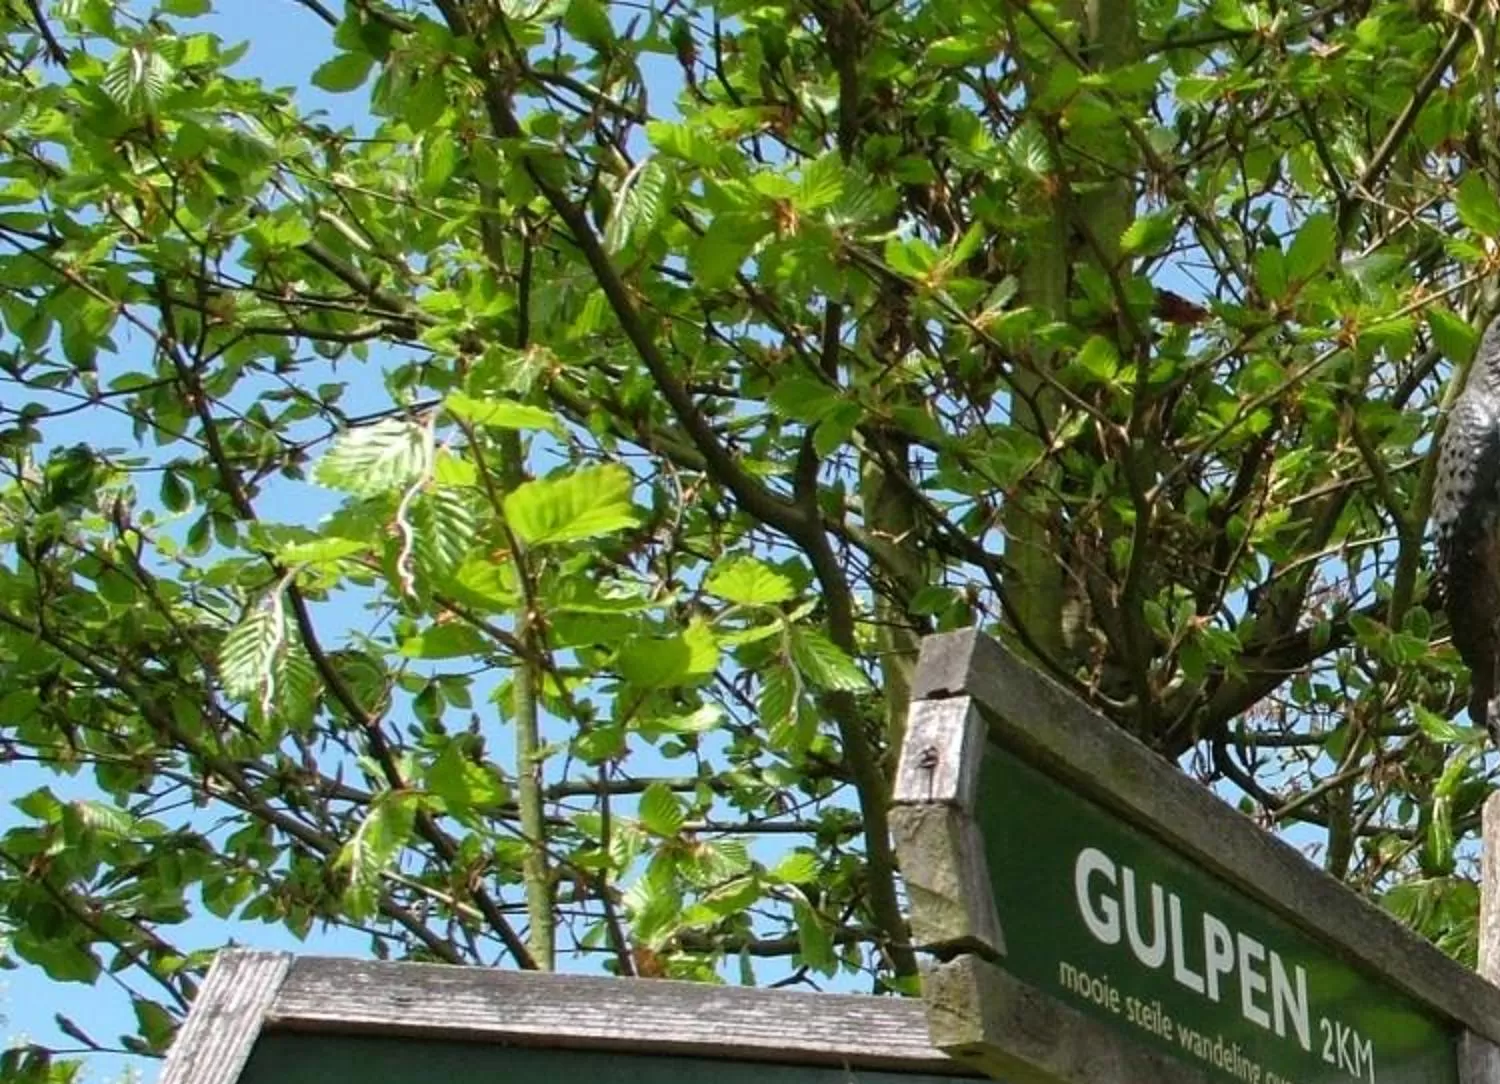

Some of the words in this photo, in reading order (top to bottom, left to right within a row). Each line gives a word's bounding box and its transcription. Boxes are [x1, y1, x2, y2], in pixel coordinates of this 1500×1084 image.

[1059, 961, 1121, 1013] mooie
[1126, 996, 1173, 1041] steile
[1074, 846, 1313, 1052] GULPEN
